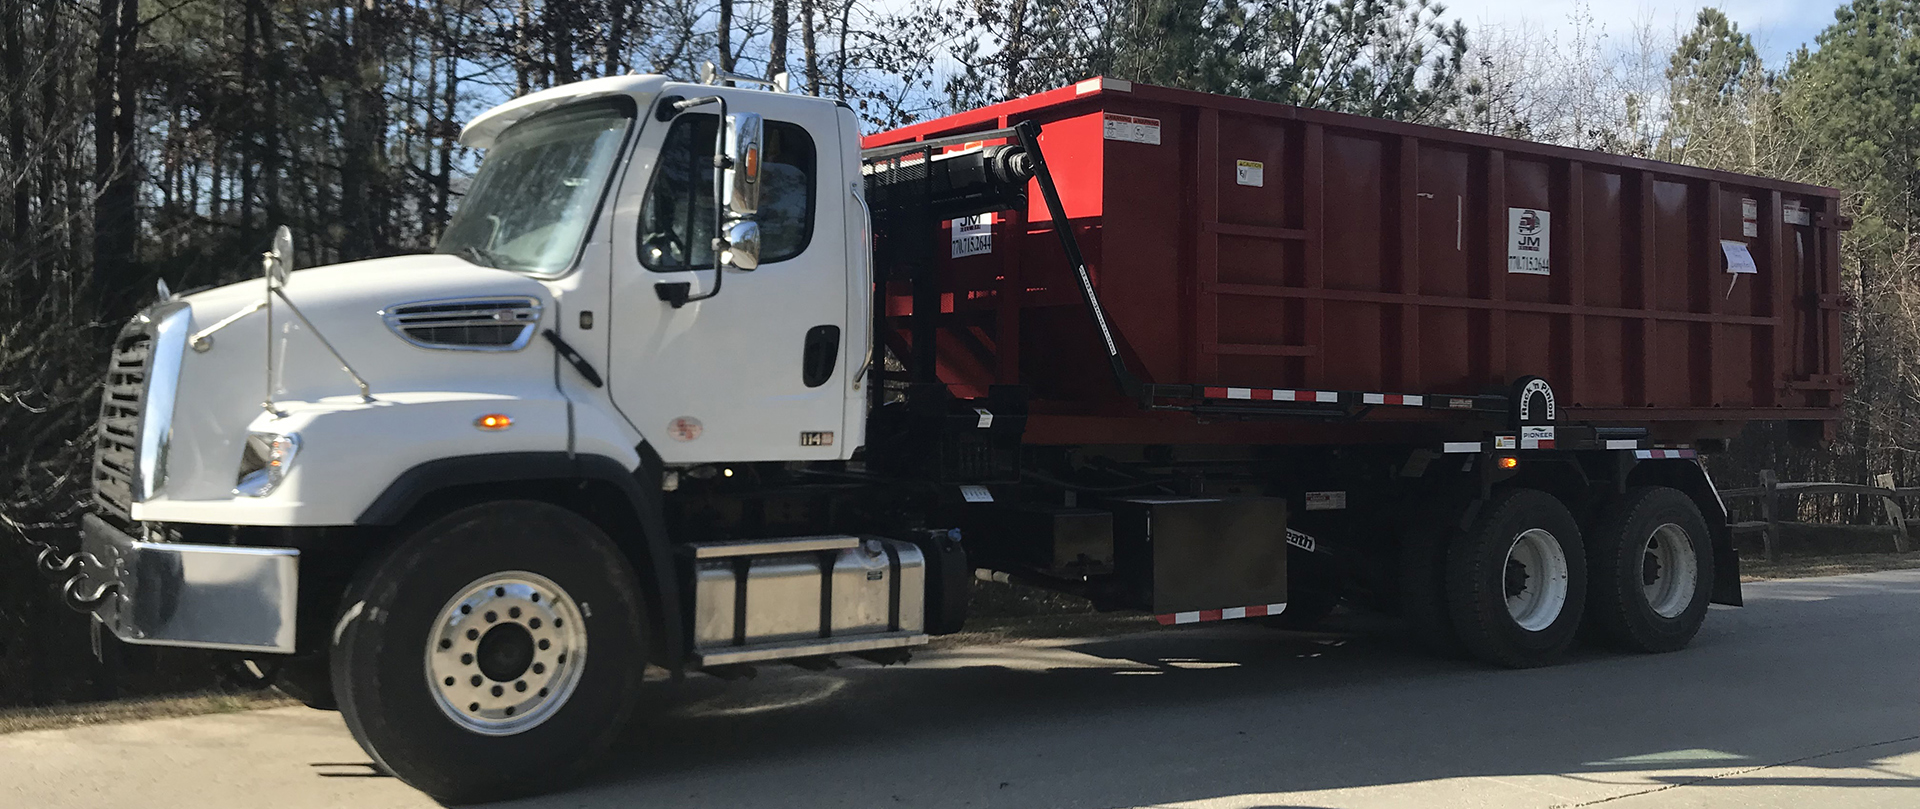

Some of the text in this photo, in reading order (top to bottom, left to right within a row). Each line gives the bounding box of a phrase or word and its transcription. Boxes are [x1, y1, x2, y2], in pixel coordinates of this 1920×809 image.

[960, 215, 981, 227] JM
[1518, 236, 1540, 247] JM
[1521, 387, 1533, 416] Rack
[1540, 382, 1554, 418] Pinion
[802, 432, 821, 445] 114
